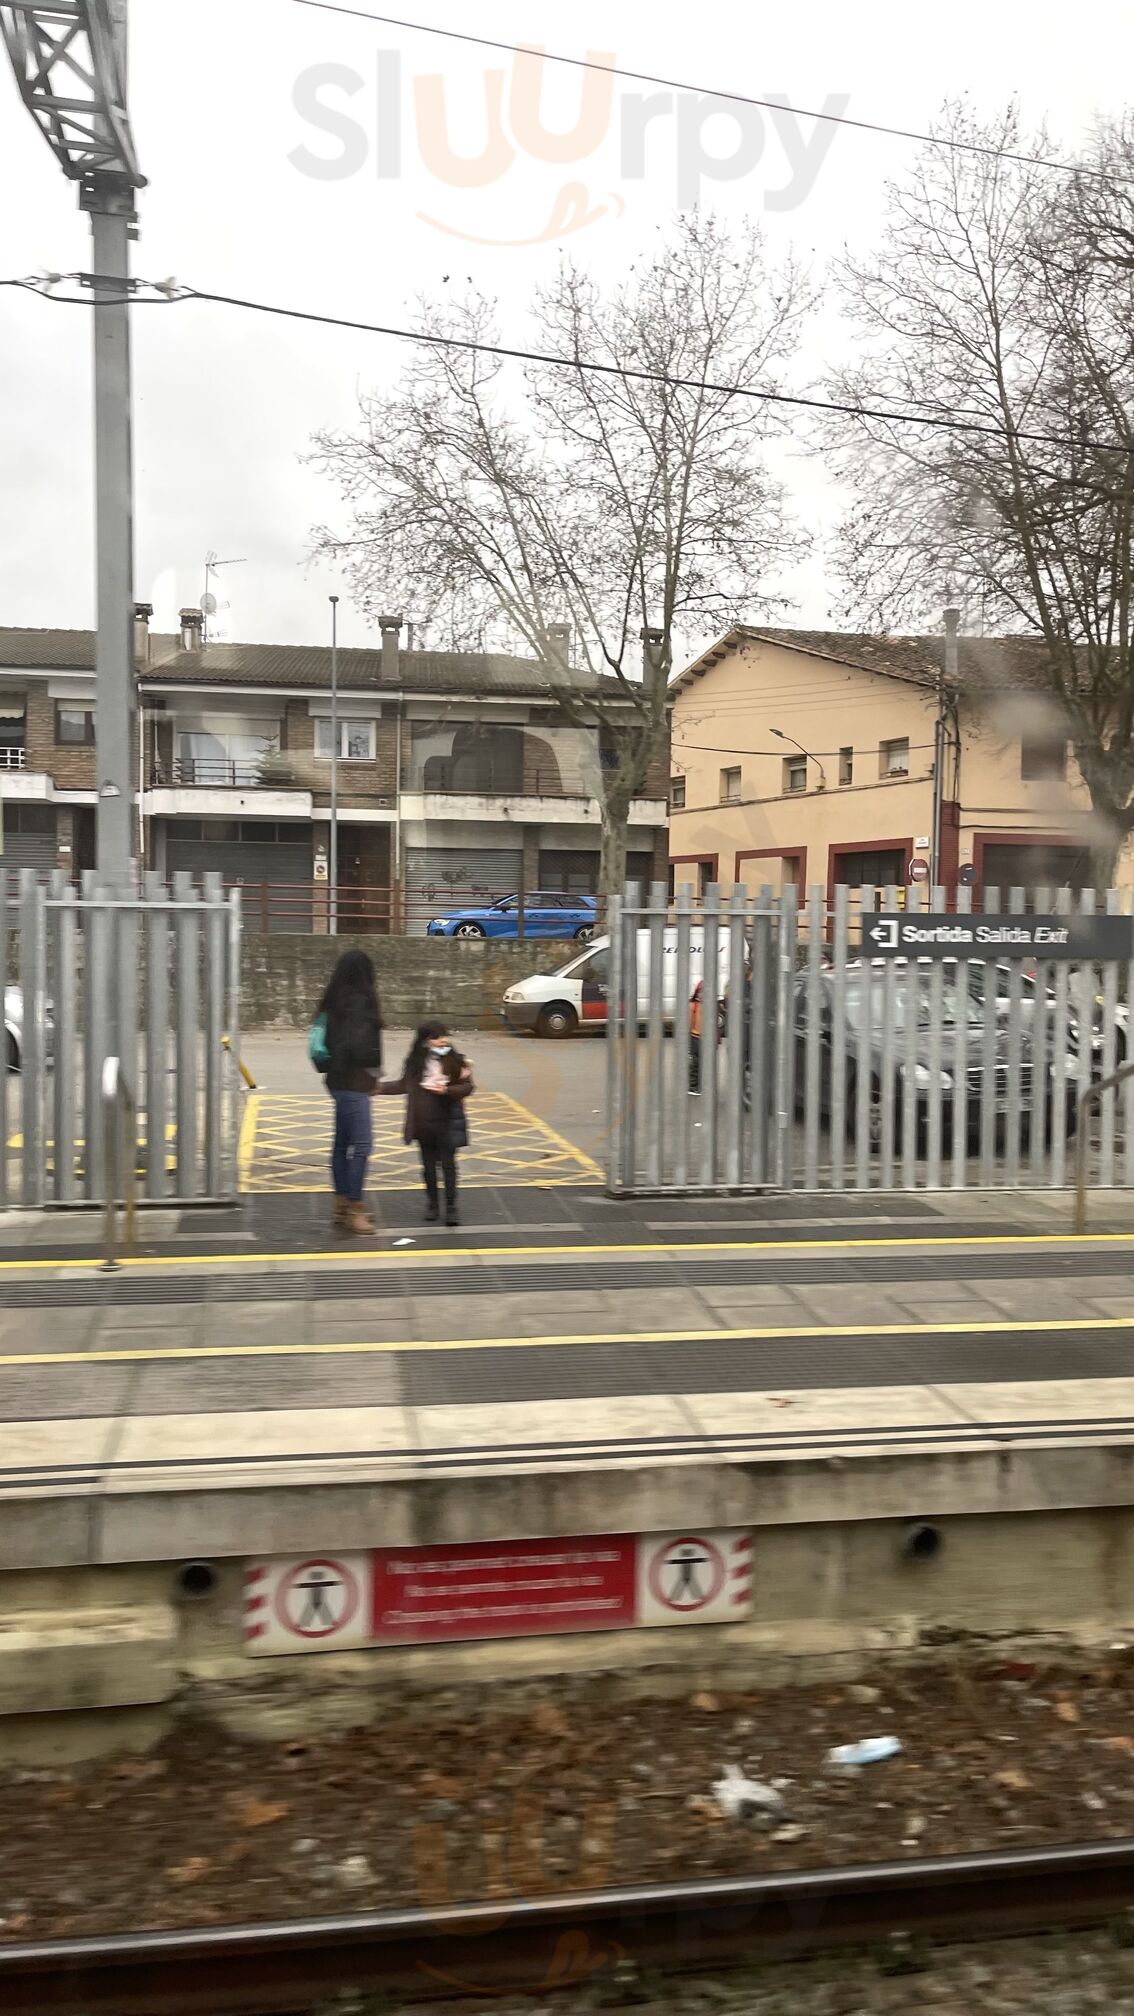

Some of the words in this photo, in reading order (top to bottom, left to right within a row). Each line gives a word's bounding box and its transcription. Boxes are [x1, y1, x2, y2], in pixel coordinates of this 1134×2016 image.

[902, 925, 973, 943] Sortida
[976, 926, 1031, 943] Salida
[1034, 927, 1069, 944] Exit
